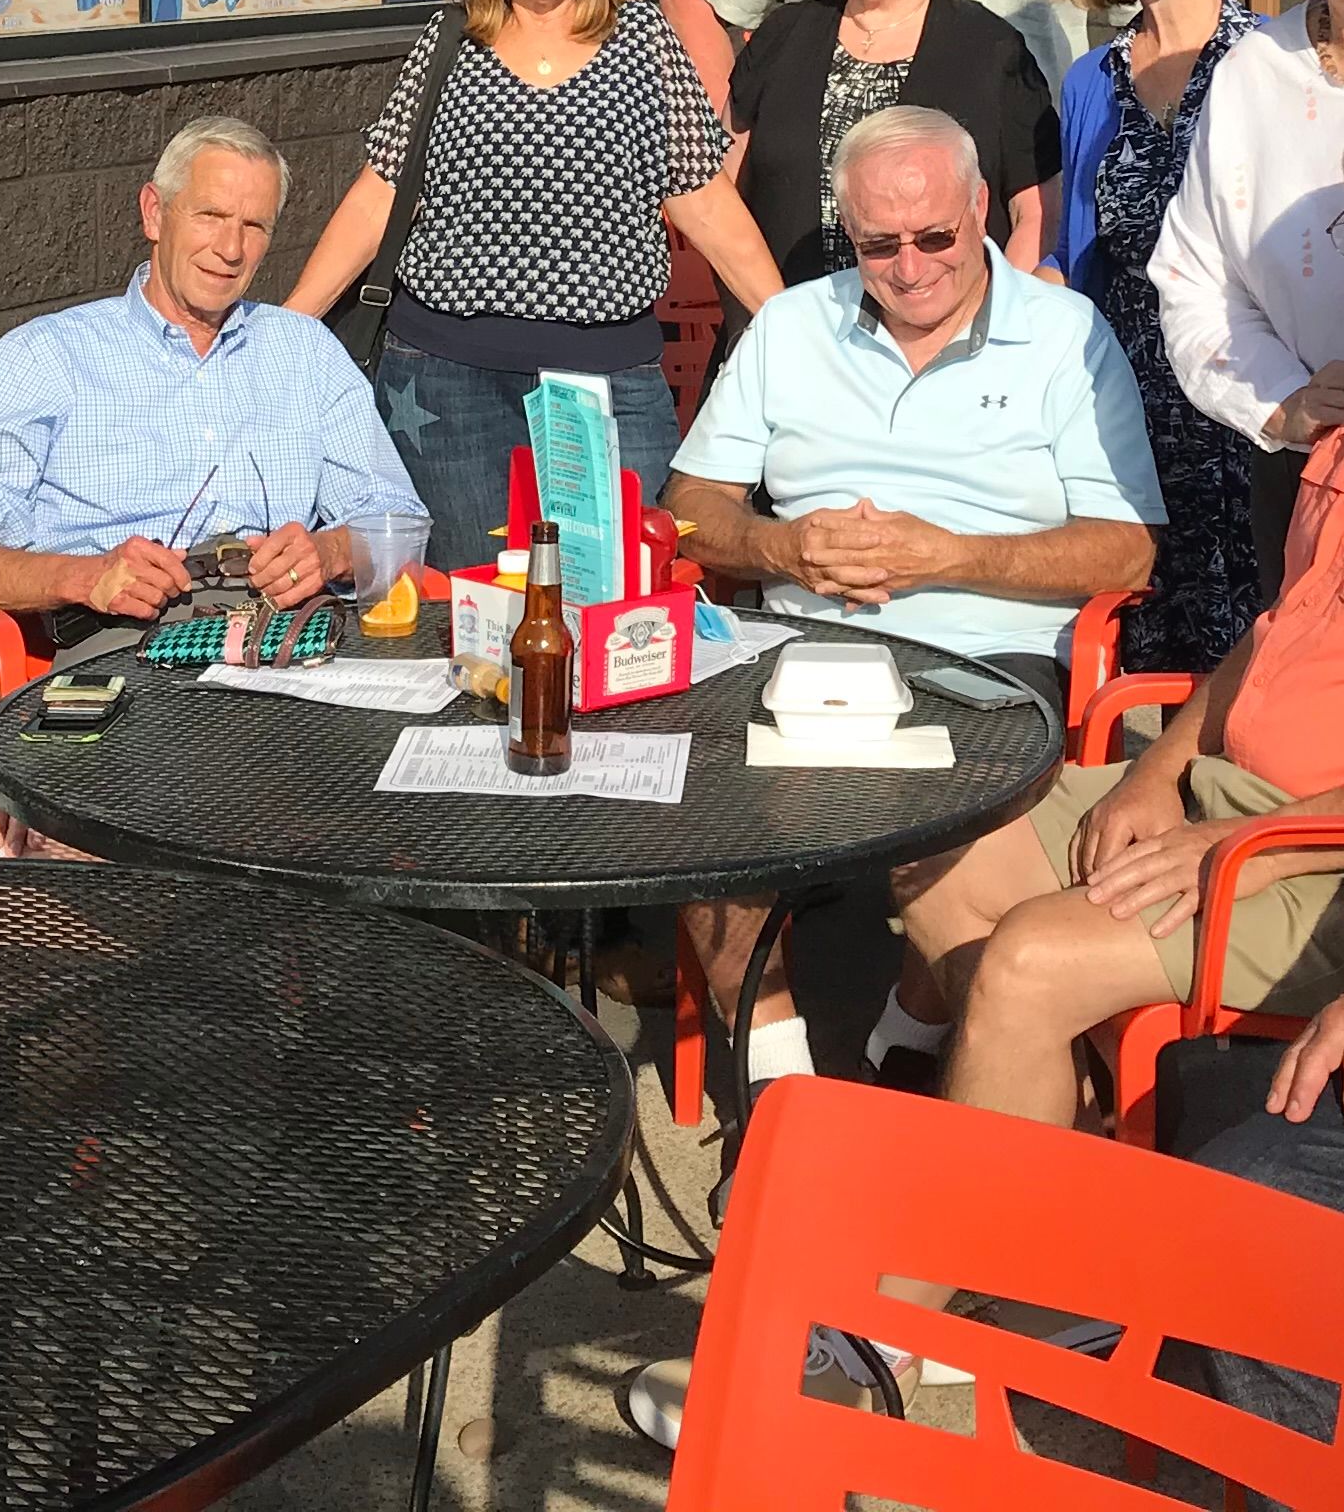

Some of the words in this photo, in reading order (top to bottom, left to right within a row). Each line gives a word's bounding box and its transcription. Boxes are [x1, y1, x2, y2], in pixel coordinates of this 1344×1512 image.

[486, 618, 503, 632] This
[487, 631, 499, 642] For
[614, 650, 667, 668] Budweiser
